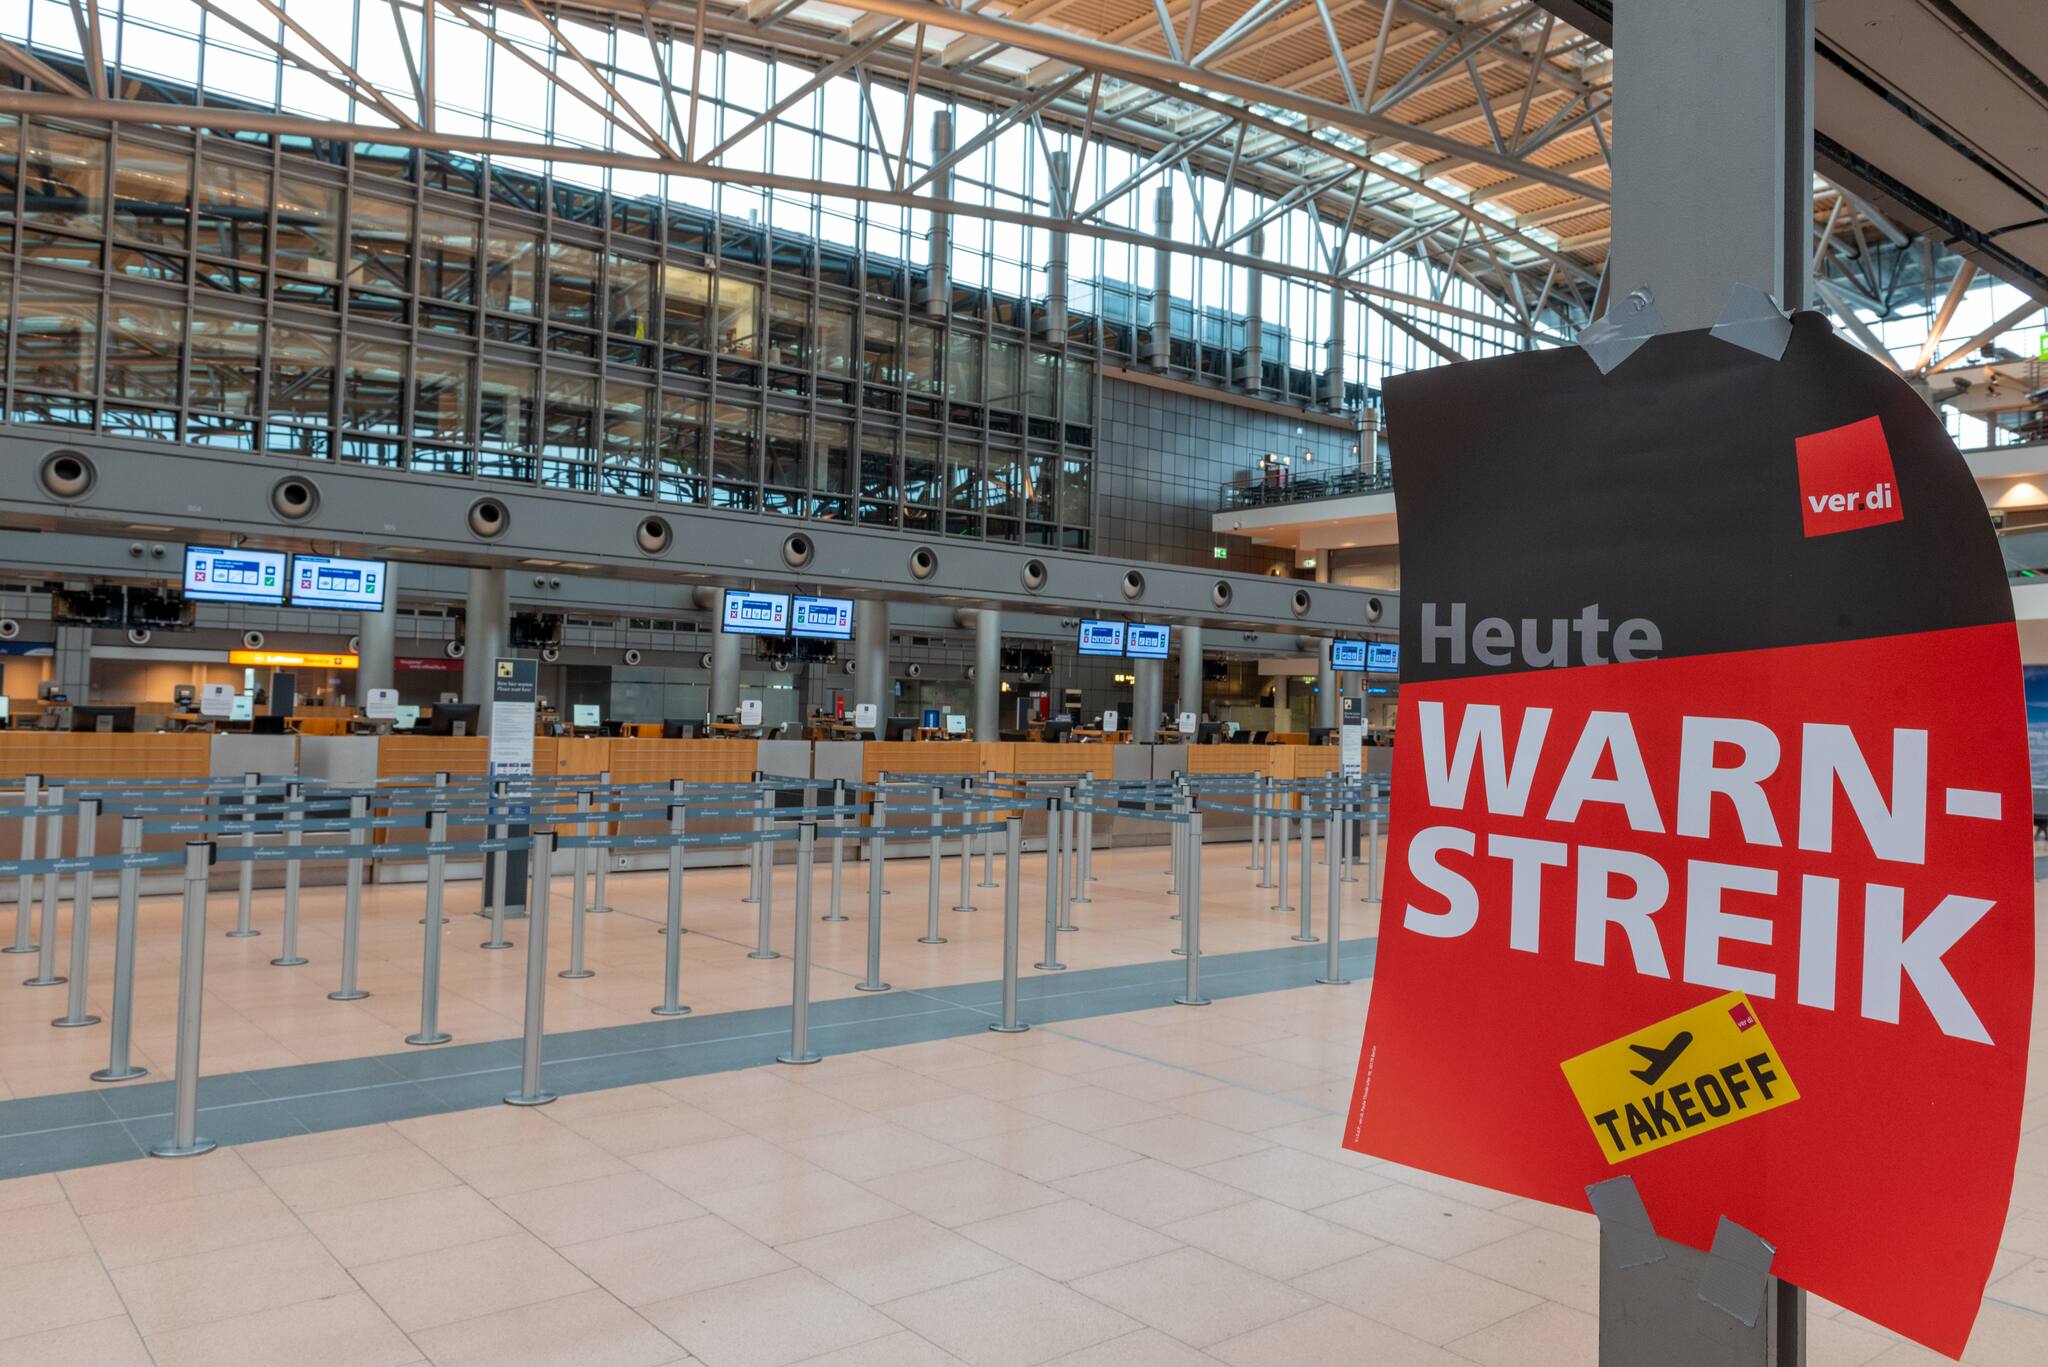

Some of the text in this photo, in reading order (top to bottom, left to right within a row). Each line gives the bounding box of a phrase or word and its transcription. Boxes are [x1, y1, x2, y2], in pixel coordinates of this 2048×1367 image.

[1808, 482, 1892, 513] ver.di
[1421, 602, 1663, 668] Heute
[1418, 701, 2002, 865] WARN-
[1403, 826, 1998, 1046] STREIK
[1594, 1052, 1778, 1153] TAKEOFF
